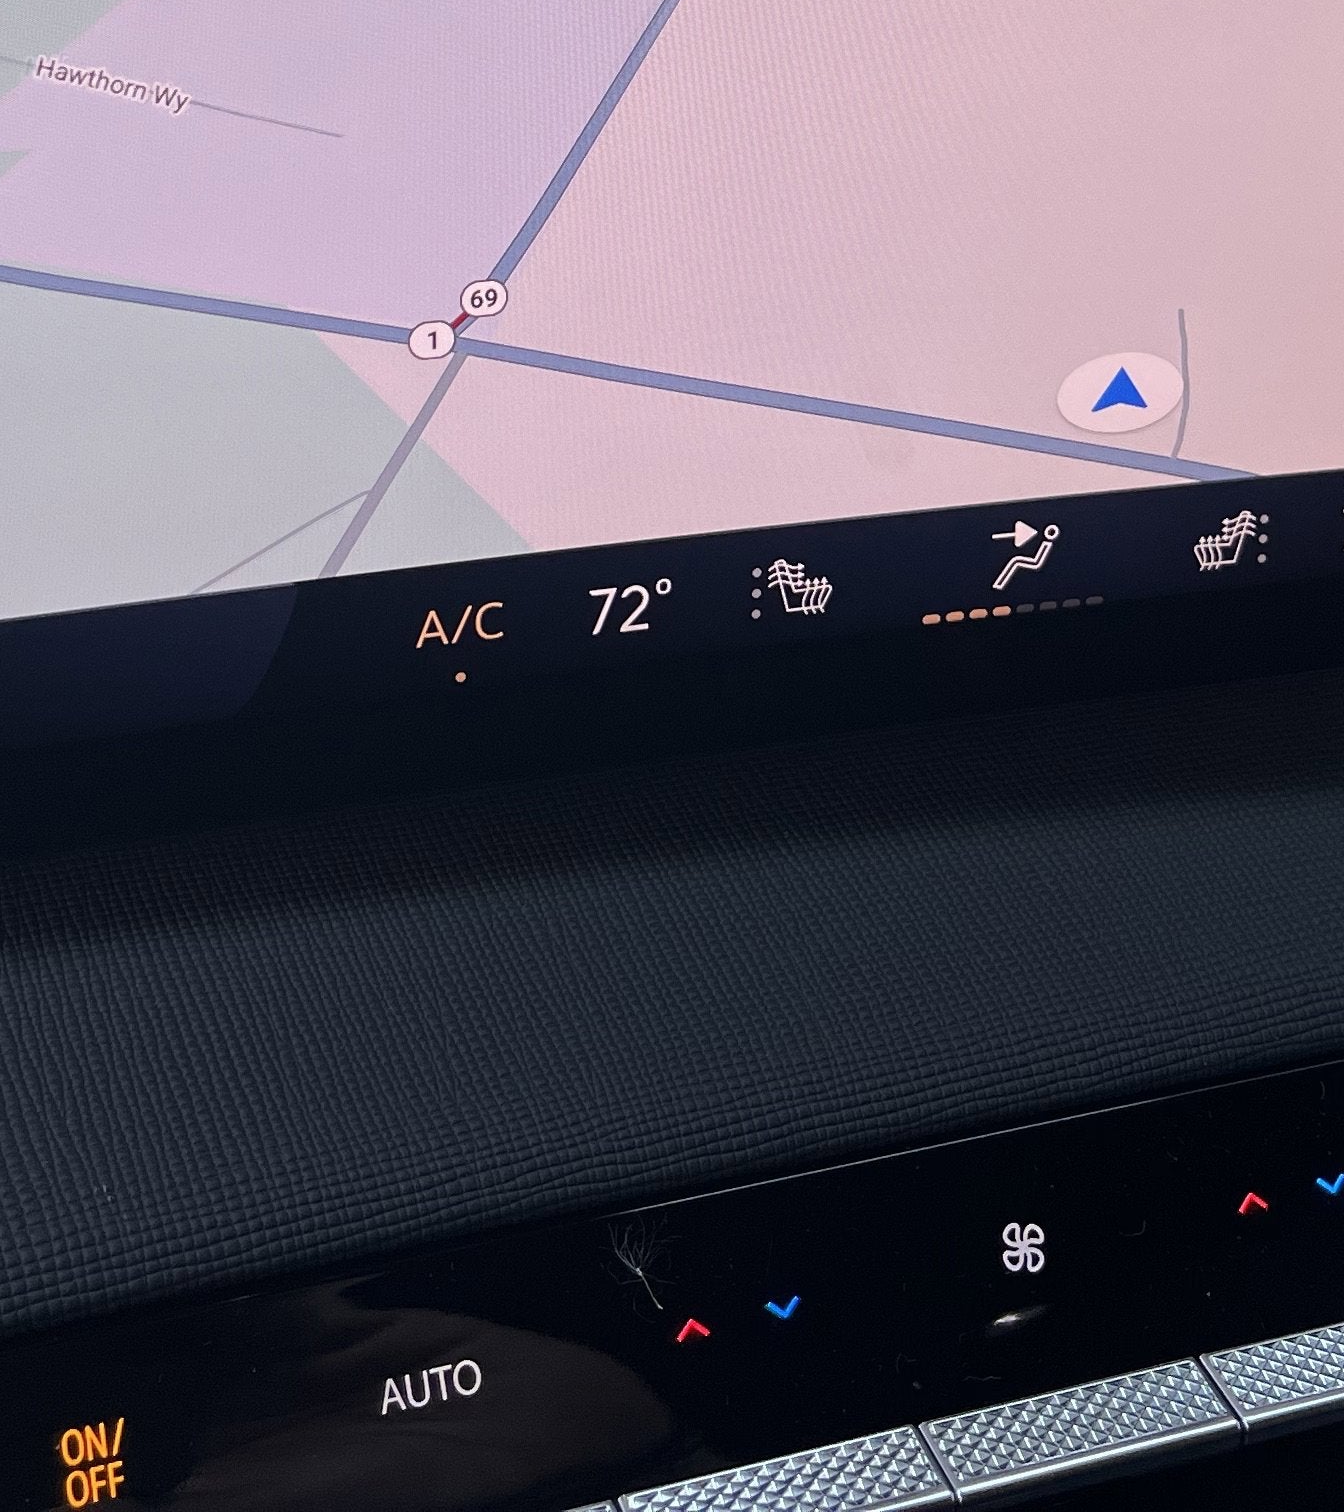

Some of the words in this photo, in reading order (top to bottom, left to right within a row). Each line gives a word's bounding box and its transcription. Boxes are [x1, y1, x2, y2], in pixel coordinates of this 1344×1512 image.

[36, 57, 147, 101] Hawthorn
[154, 85, 189, 114] Wy
[471, 288, 498, 309] 69
[427, 331, 437, 350] 1
[415, 601, 505, 649] A/C
[588, 578, 672, 635] 72°
[380, 1359, 482, 1416] AUTO
[60, 1417, 125, 1466] ON/
[65, 1460, 125, 1509] OFF
